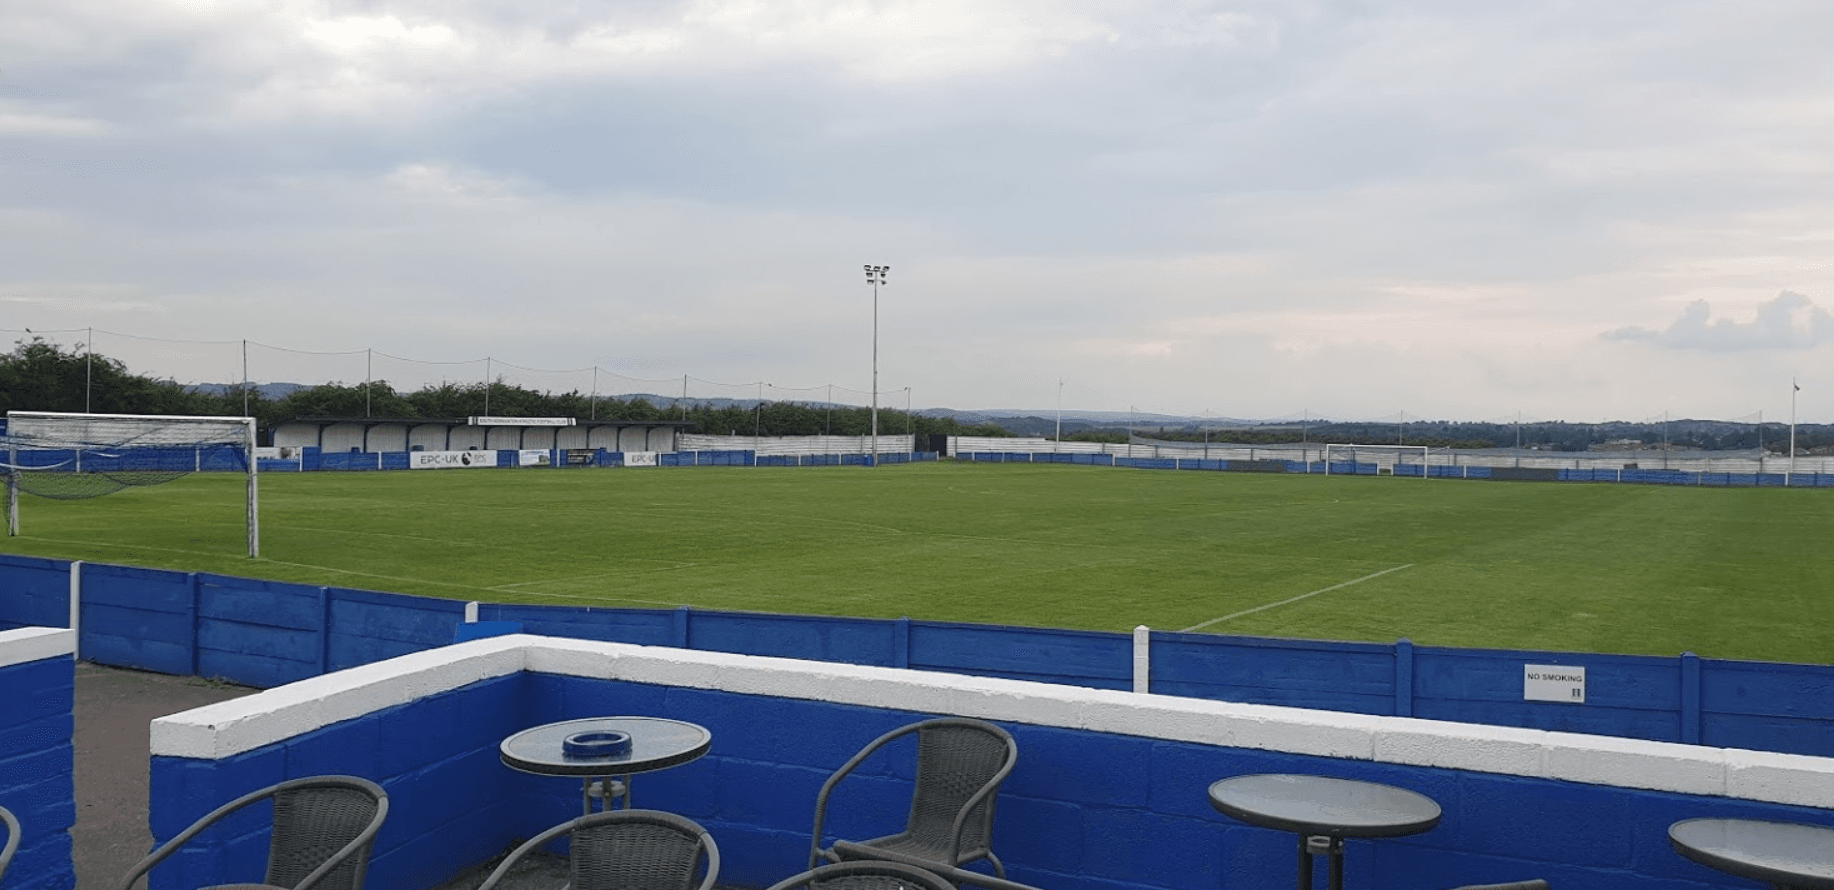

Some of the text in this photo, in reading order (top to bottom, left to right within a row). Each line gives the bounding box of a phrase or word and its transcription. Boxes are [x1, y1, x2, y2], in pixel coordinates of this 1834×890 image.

[420, 454, 459, 465] EPC-UK
[631, 454, 655, 463] EPC-U
[1542, 673, 1583, 682] SMOKING
